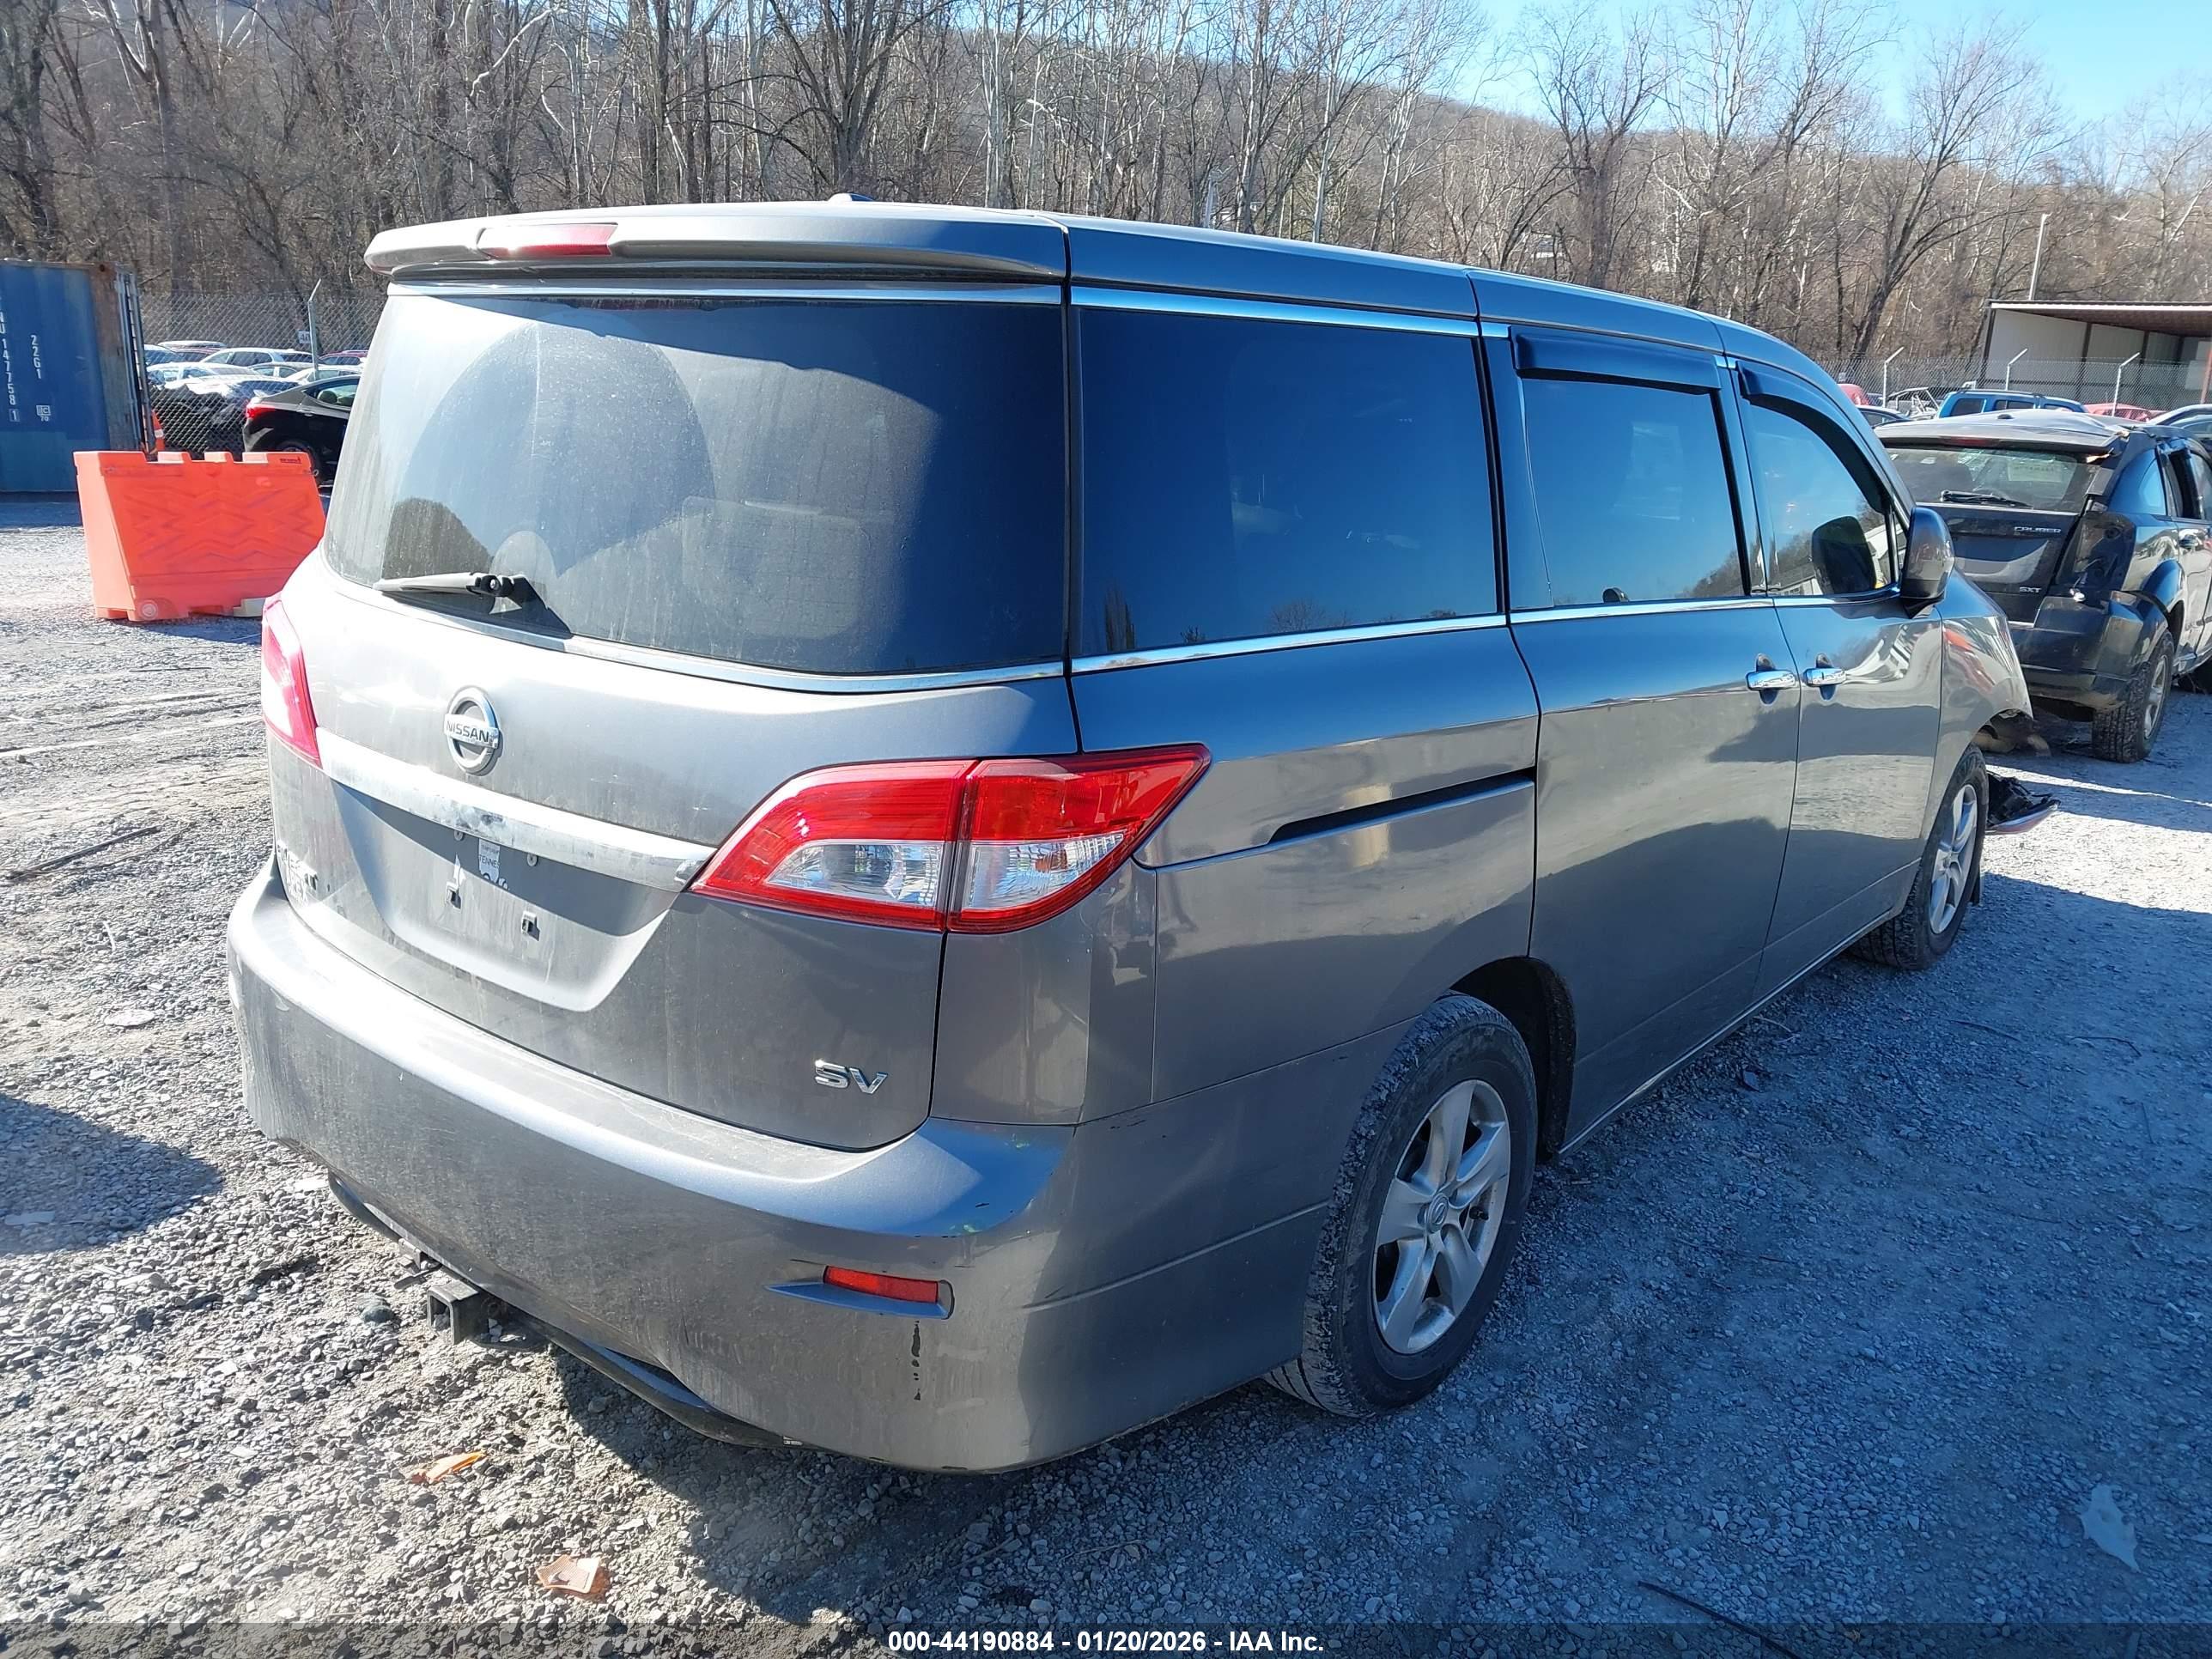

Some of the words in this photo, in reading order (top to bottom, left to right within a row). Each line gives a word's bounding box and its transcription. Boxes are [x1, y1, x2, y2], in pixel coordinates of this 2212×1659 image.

[2, 338, 16, 406] 147758
[30, 334, 42, 380] 22G1
[446, 720, 489, 743] NISSAN
[814, 1059, 889, 1095] SV
